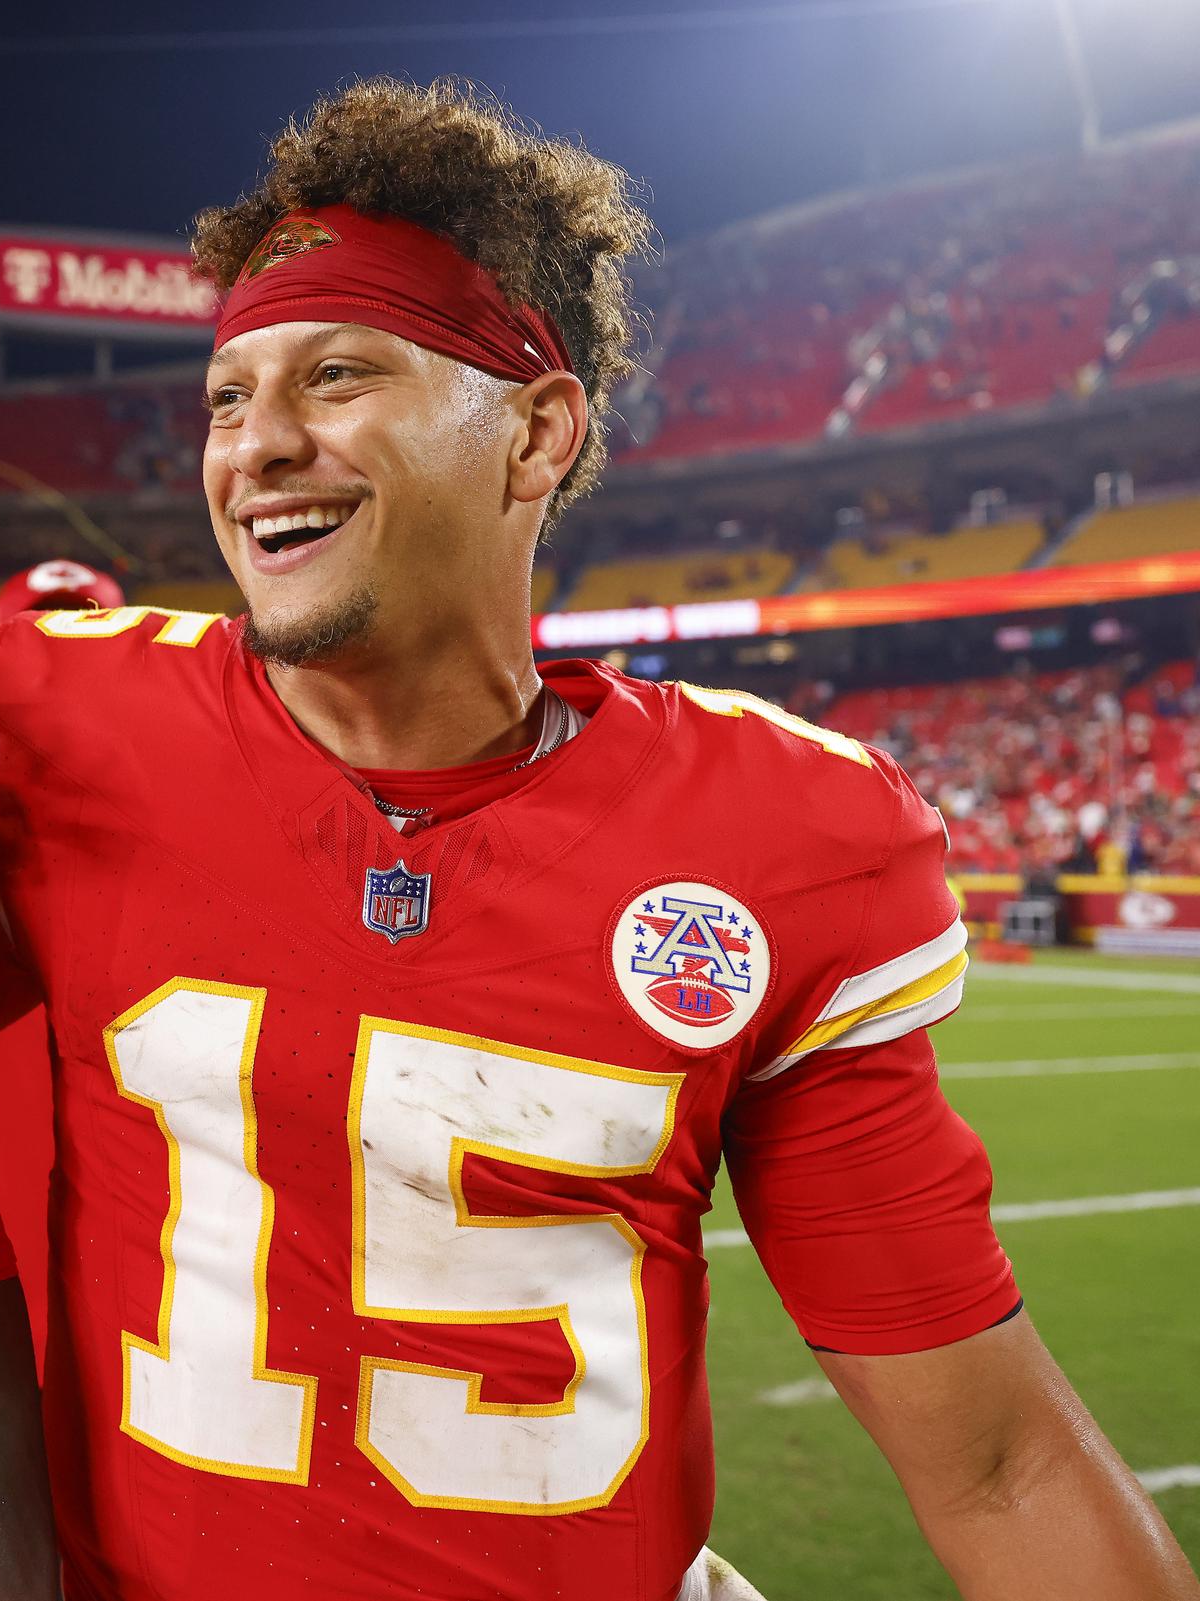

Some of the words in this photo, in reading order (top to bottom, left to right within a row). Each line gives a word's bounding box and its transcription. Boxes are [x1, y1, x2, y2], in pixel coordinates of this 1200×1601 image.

[372, 895, 419, 928] NFL
[676, 988, 714, 1014] LH
[103, 975, 688, 1516] 15
